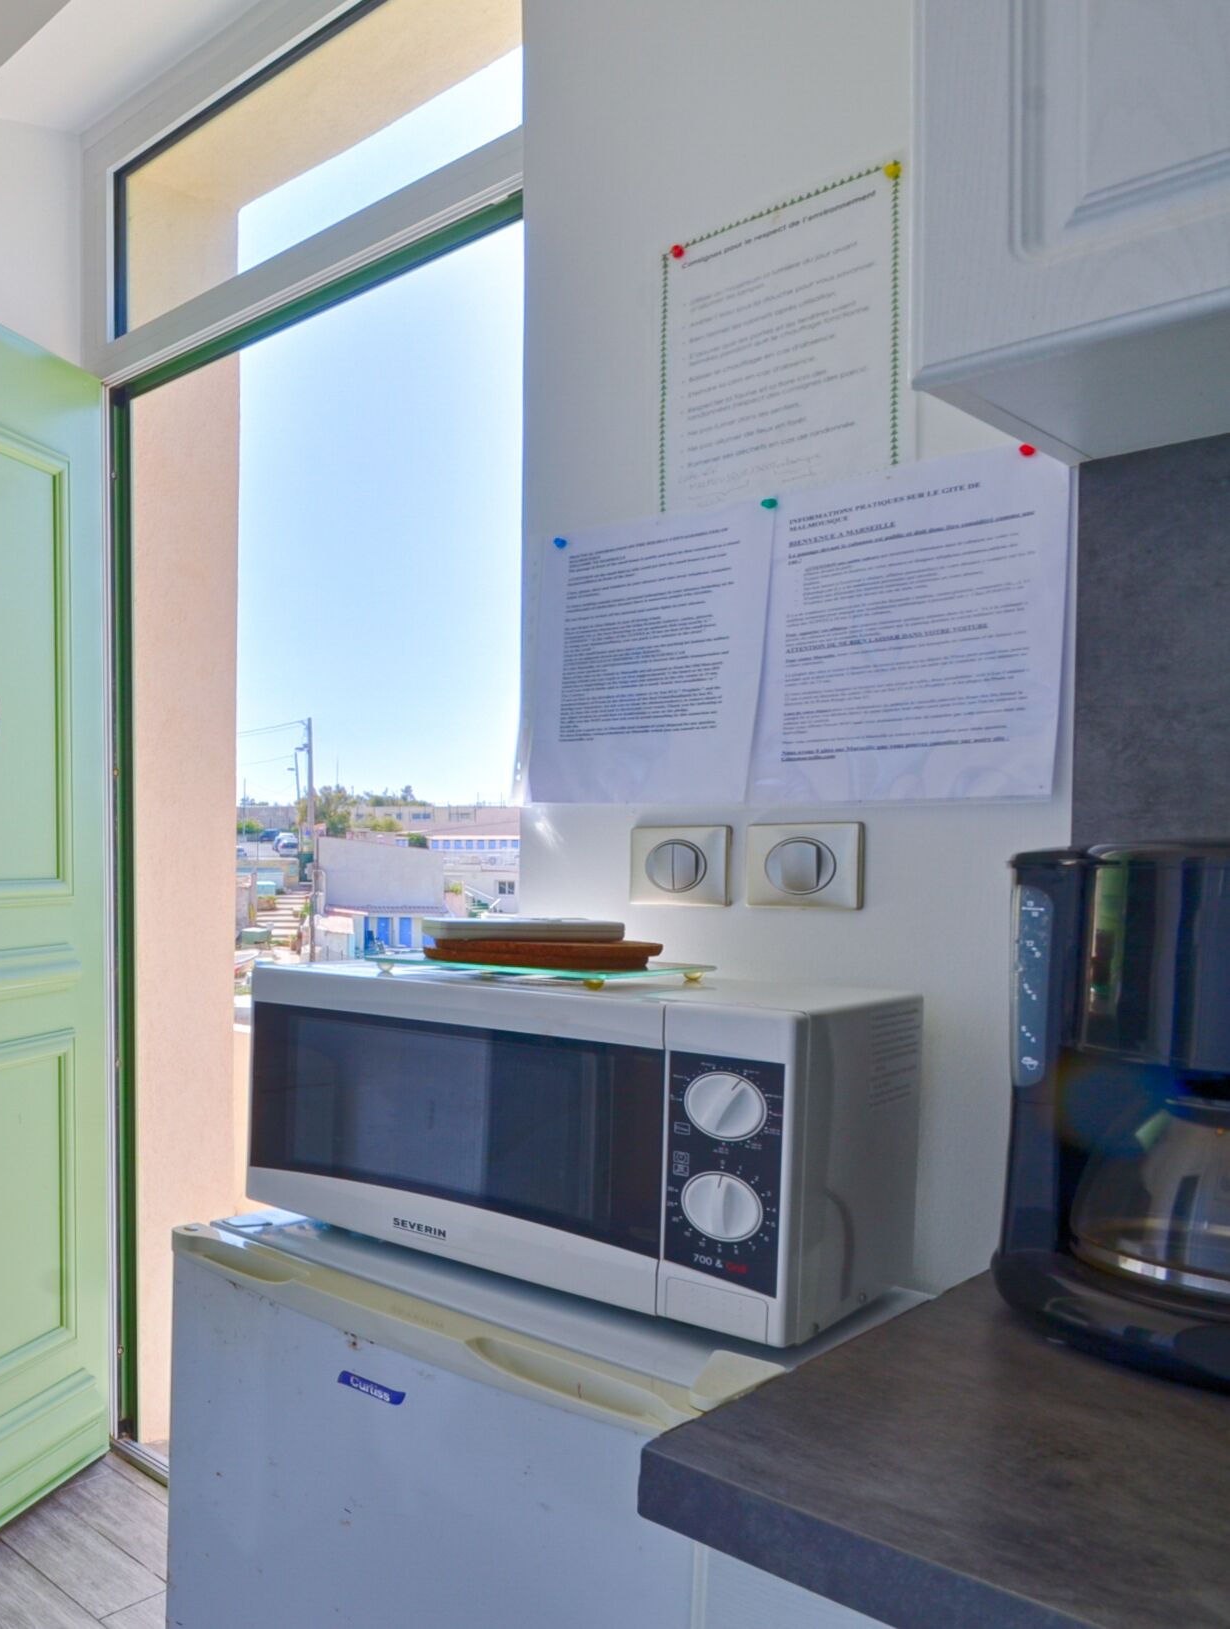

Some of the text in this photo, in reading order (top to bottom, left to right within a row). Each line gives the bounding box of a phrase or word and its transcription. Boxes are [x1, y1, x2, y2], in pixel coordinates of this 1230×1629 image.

[682, 249, 721, 270] Consignes
[723, 241, 741, 254] pour
[743, 237, 751, 246] le
[753, 224, 786, 243] respect
[788, 218, 800, 230] de
[789, 481, 981, 525] INFORMATIONS PRATIQUES SUR LE GITE DE
[846, 521, 896, 537] MARSEILLE
[393, 1217, 447, 1238] SEVERIN
[693, 1253, 713, 1267] 700
[715, 1260, 723, 1269] &
